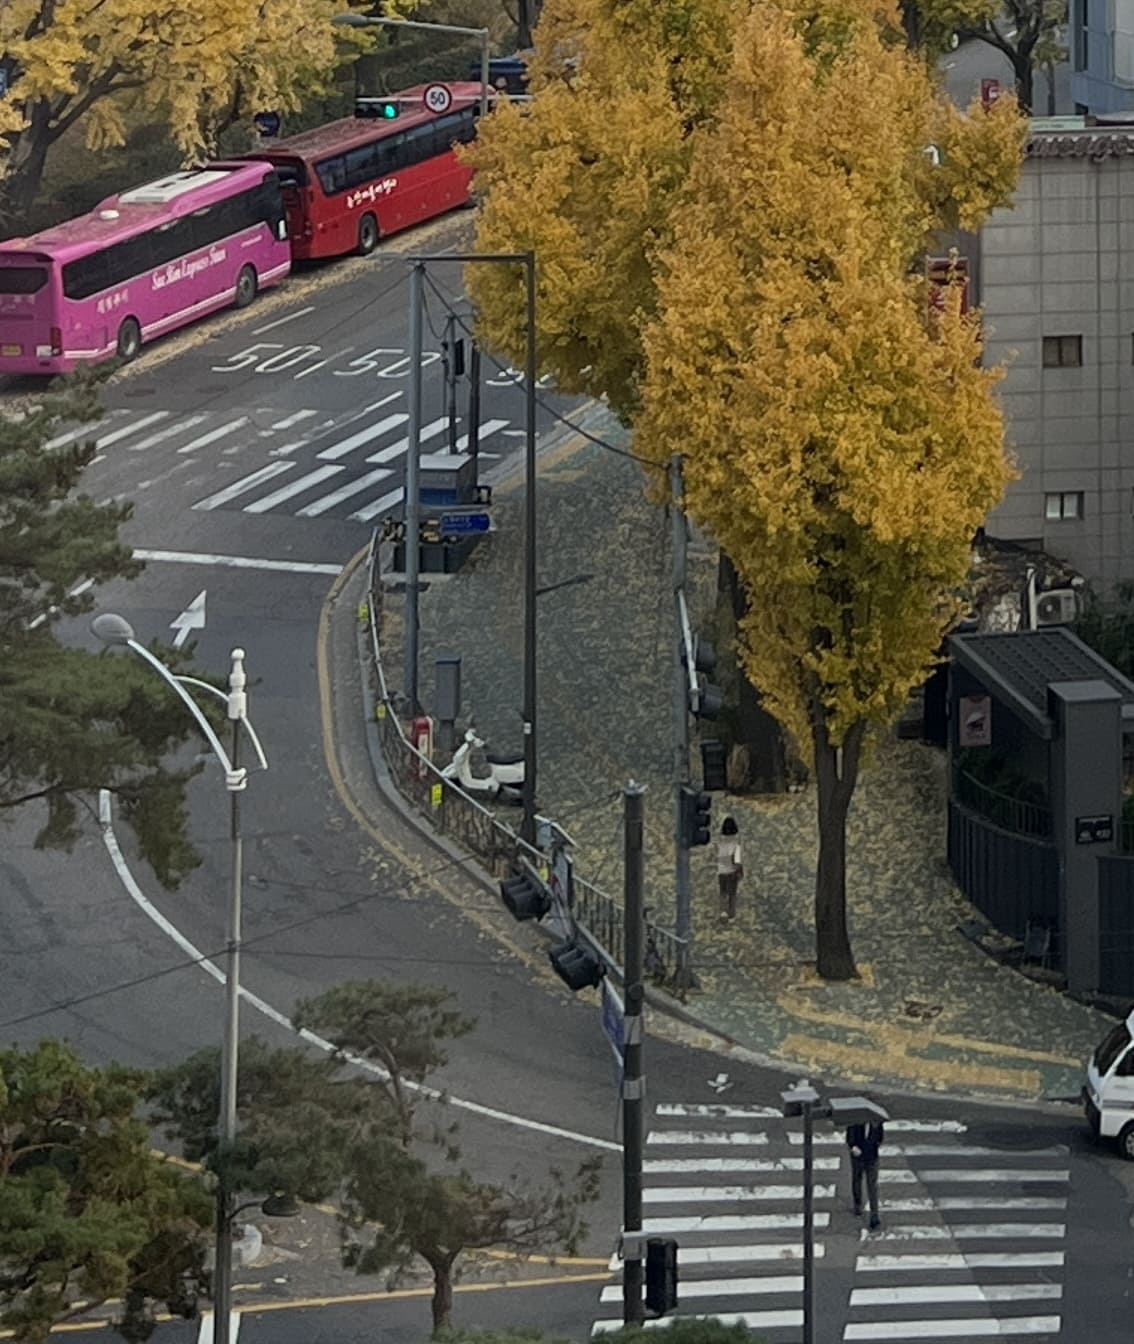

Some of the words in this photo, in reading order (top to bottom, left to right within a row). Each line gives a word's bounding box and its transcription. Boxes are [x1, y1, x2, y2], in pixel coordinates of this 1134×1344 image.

[430, 91, 445, 105] 50
[211, 343, 322, 373] 50
[333, 348, 441, 378] 50
